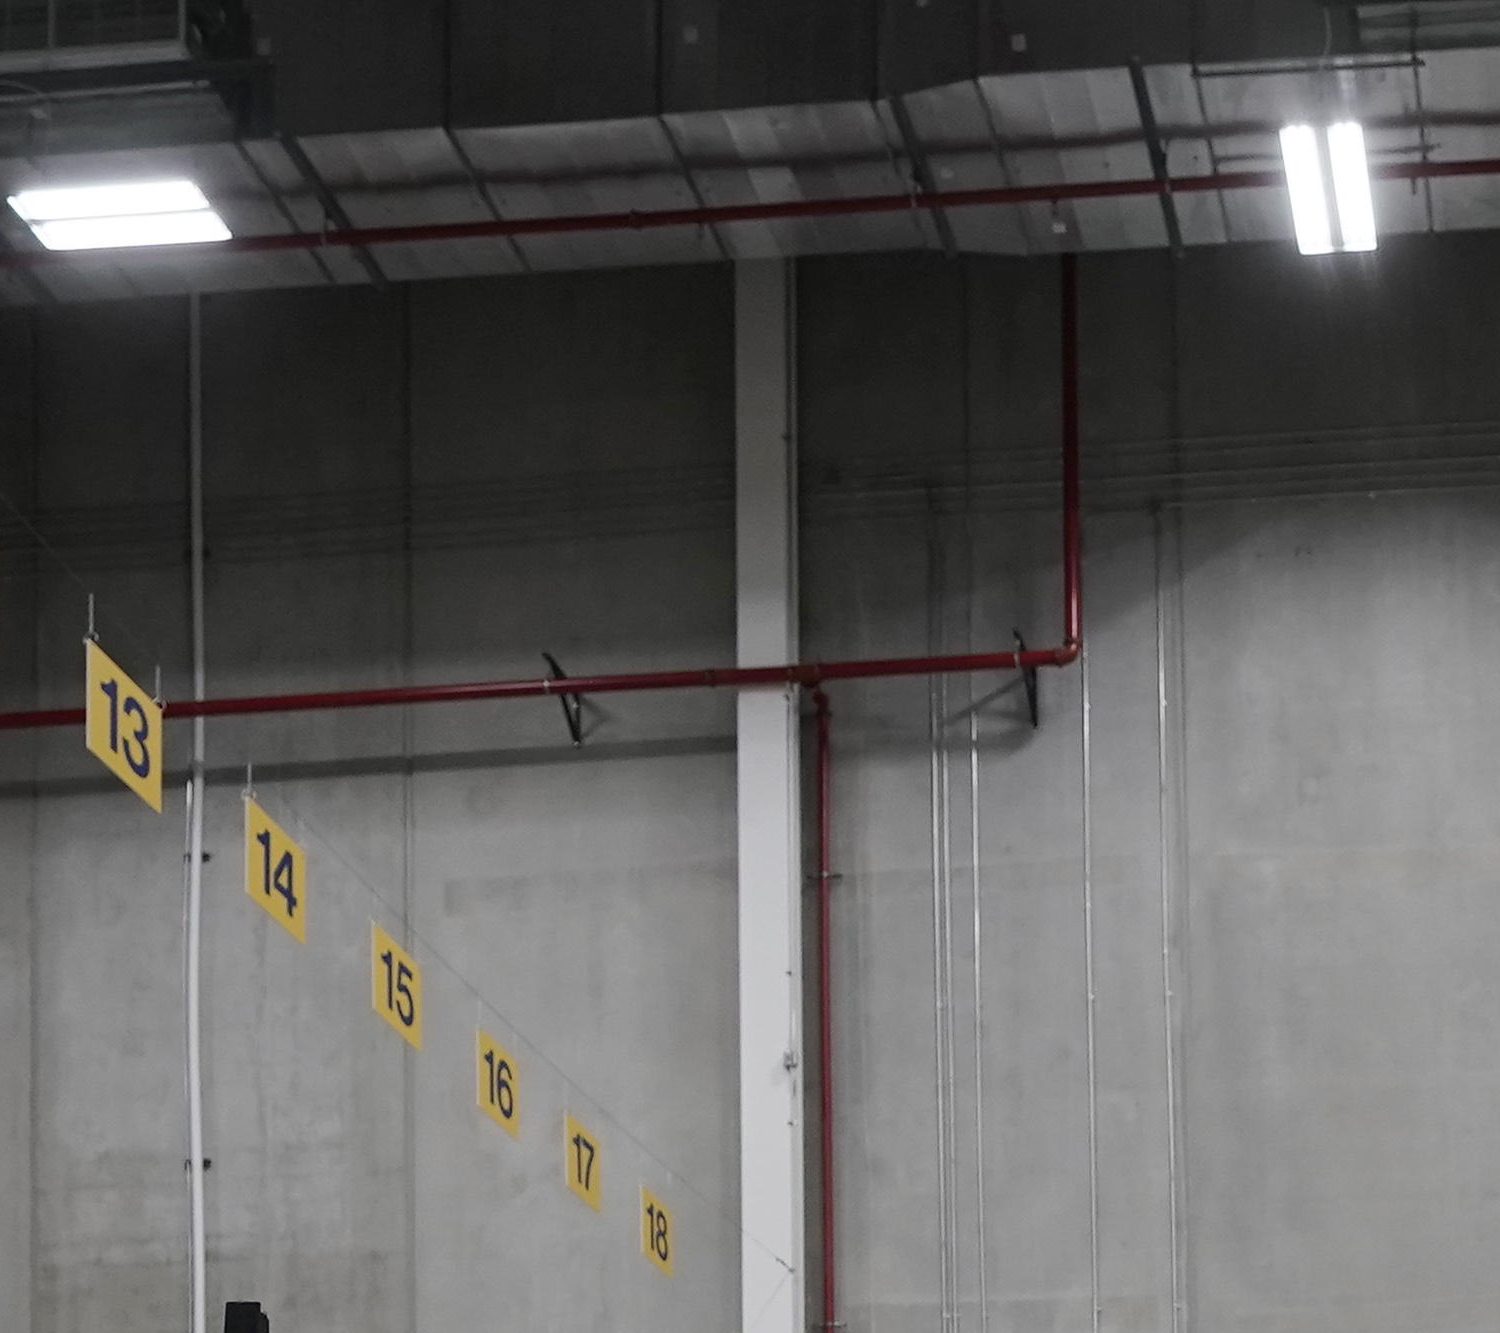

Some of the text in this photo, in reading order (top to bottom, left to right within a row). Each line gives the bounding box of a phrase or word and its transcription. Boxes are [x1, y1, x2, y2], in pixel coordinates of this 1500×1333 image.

[100, 677, 150, 779] 13
[256, 828, 297, 916] 14
[381, 949, 415, 1028] 15
[484, 1047, 513, 1120] 16
[572, 1133, 595, 1193] 17
[645, 1201, 668, 1263] 18
